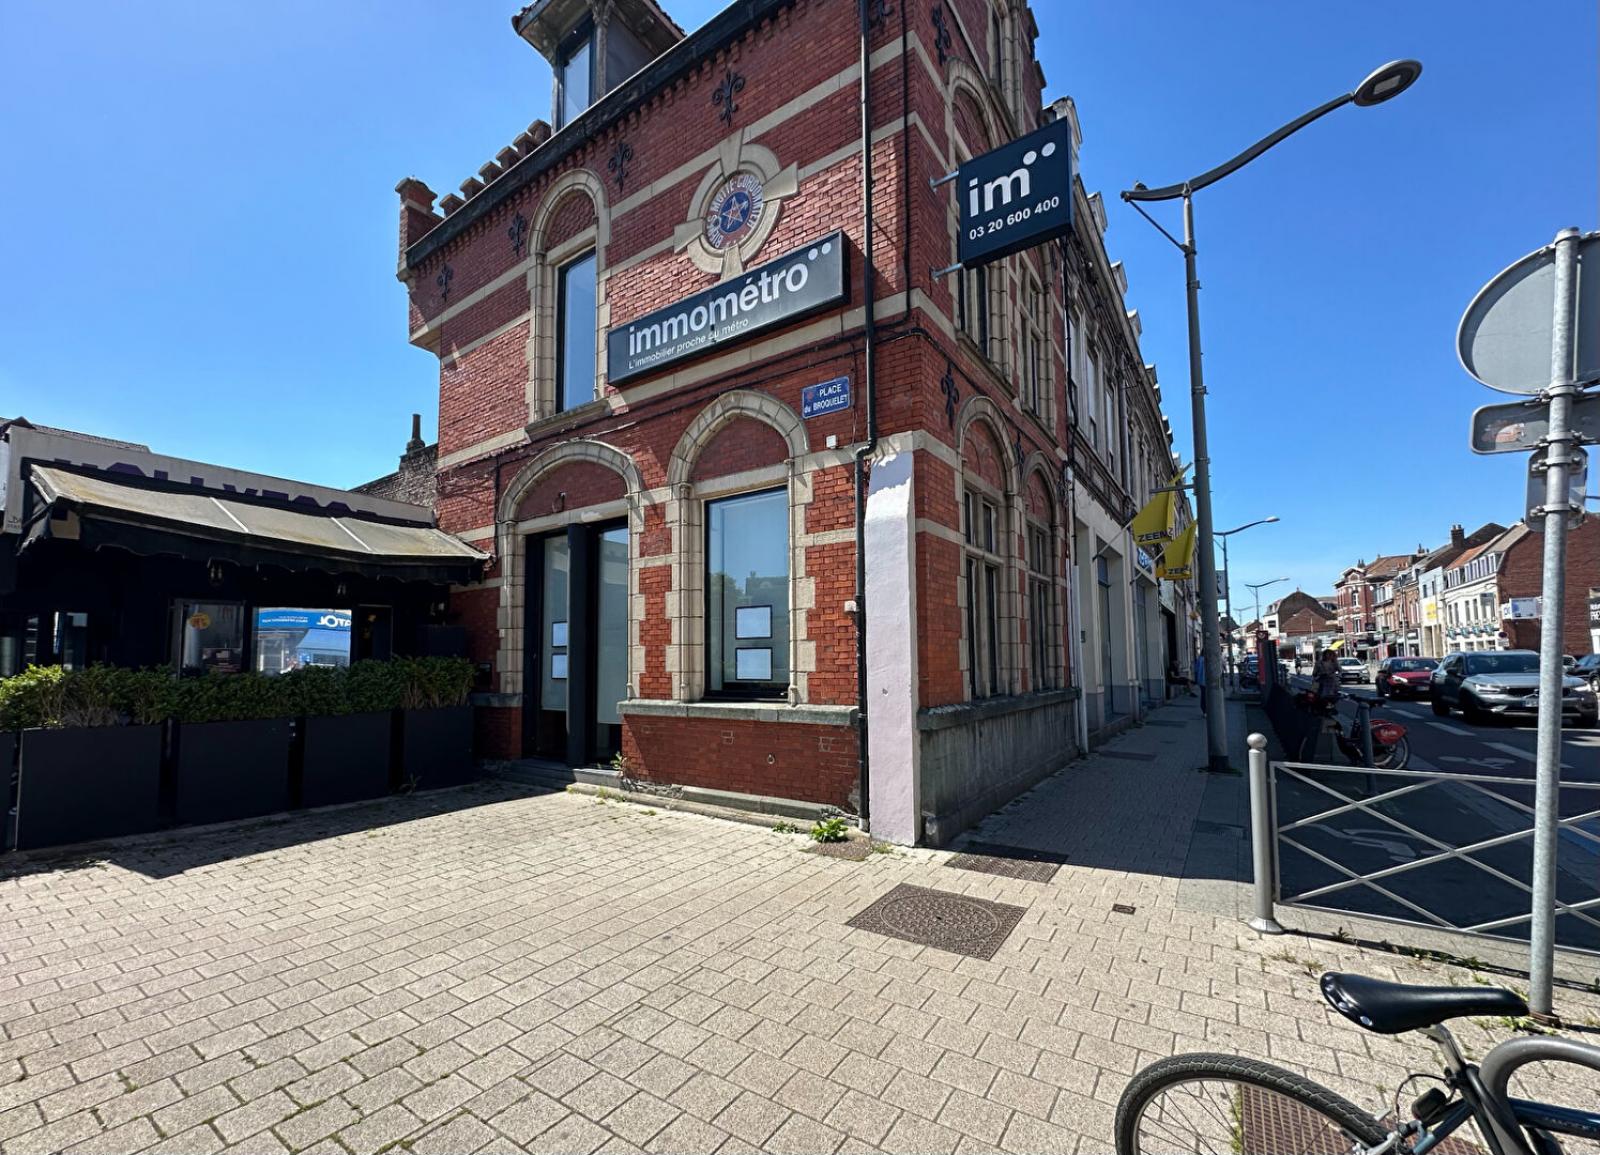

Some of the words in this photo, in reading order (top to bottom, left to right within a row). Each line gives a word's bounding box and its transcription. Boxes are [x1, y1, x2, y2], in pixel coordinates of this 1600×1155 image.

[969, 168, 1030, 217] im
[968, 226, 985, 240] 03
[987, 218, 1004, 234] 20
[1006, 207, 1032, 226] 600
[1034, 196, 1060, 214] 400
[628, 262, 809, 357] immométro
[676, 335, 706, 353] proche
[721, 317, 749, 335] métro
[813, 394, 849, 411] BROQUELET
[819, 384, 842, 397] PLACE
